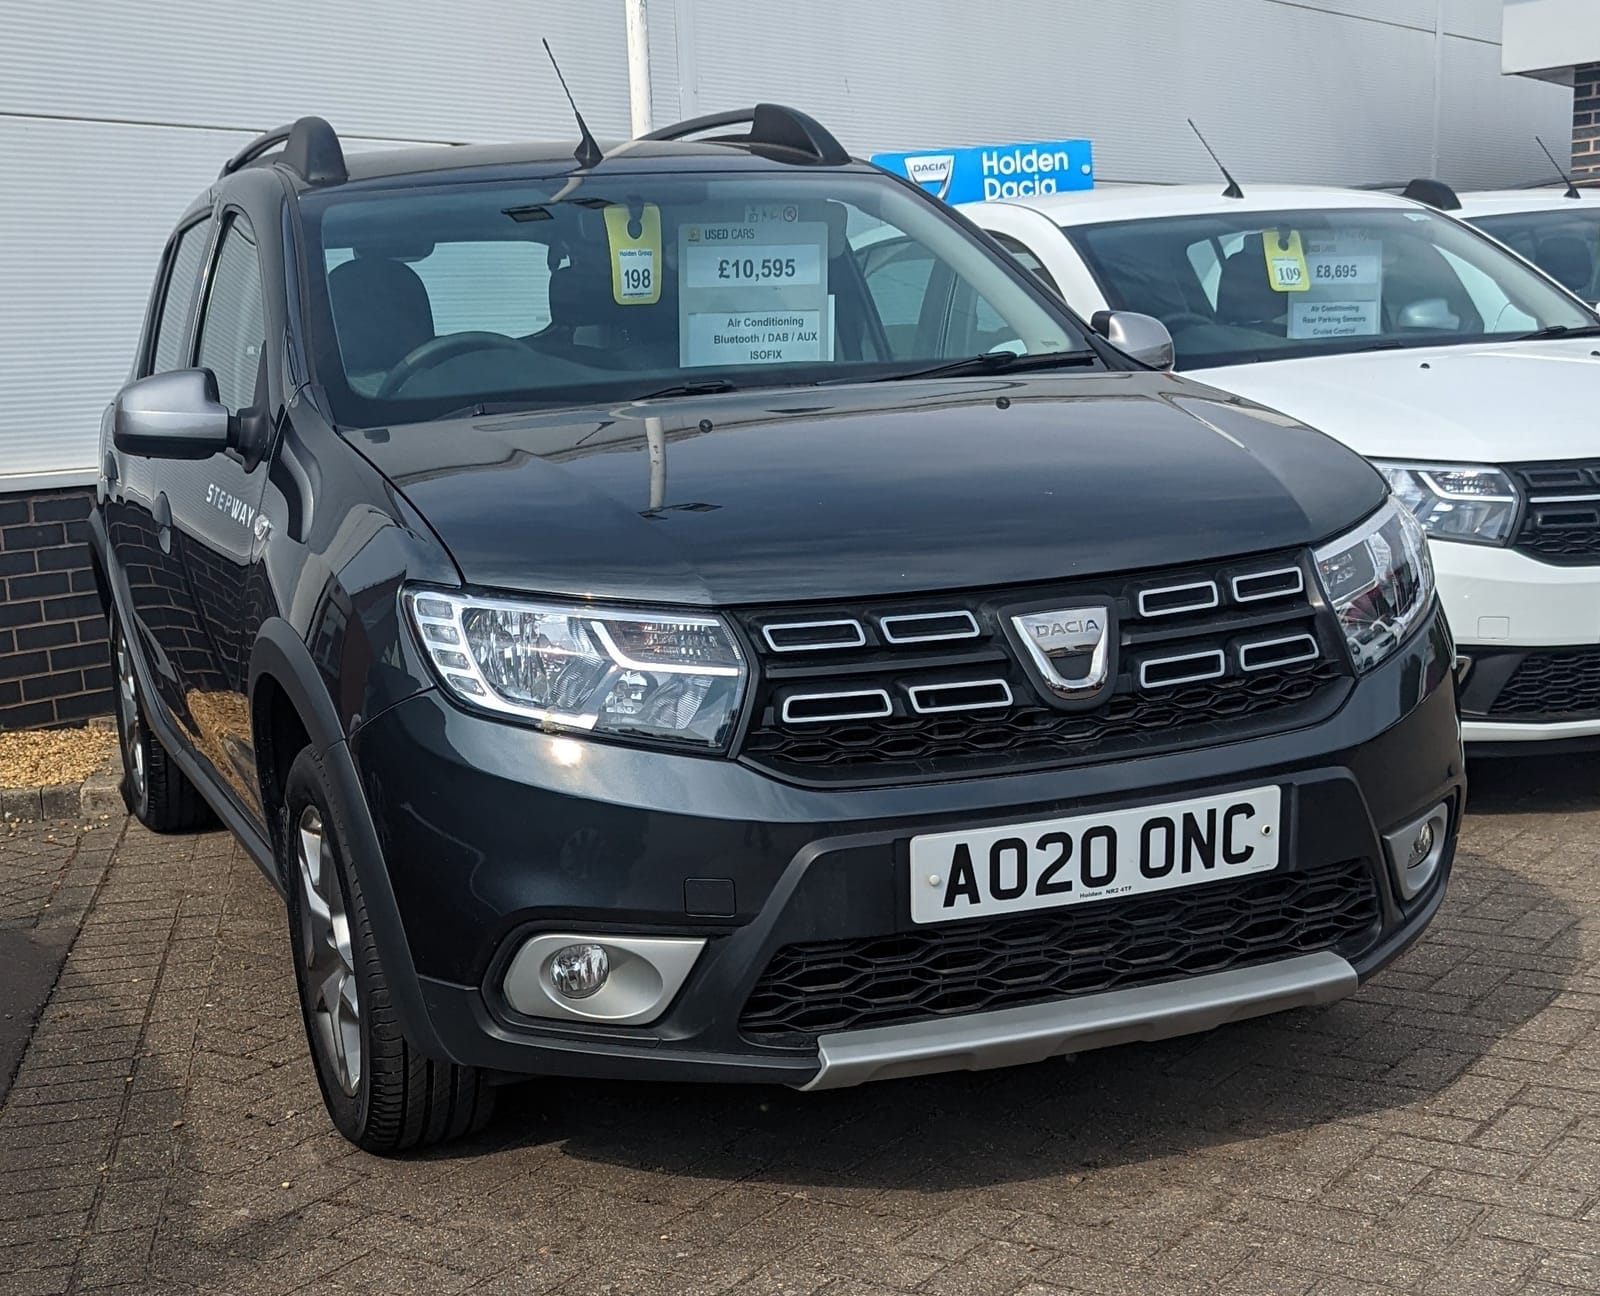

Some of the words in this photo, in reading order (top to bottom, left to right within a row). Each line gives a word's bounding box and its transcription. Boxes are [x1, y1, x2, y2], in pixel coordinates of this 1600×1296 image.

[913, 162, 947, 172] DACIA
[981, 149, 1069, 176] Holden
[983, 175, 1057, 200] Dacia
[704, 228, 729, 241] USED
[731, 228, 755, 240] CARS
[624, 268, 651, 289] 198
[718, 258, 796, 282] £10,595
[1279, 267, 1301, 281] 109
[1316, 263, 1357, 280] £8,695
[727, 318, 742, 328] Air
[743, 316, 804, 328] Conditioning
[713, 333, 760, 345] Bluetooth
[767, 332, 789, 343] DAB
[797, 331, 818, 342] AUX
[750, 349, 783, 361] ISOFIX
[206, 483, 255, 528] STEPWAY
[1035, 619, 1100, 638] DACIA
[942, 824, 1118, 908] AO20
[1139, 802, 1256, 879] ONC
